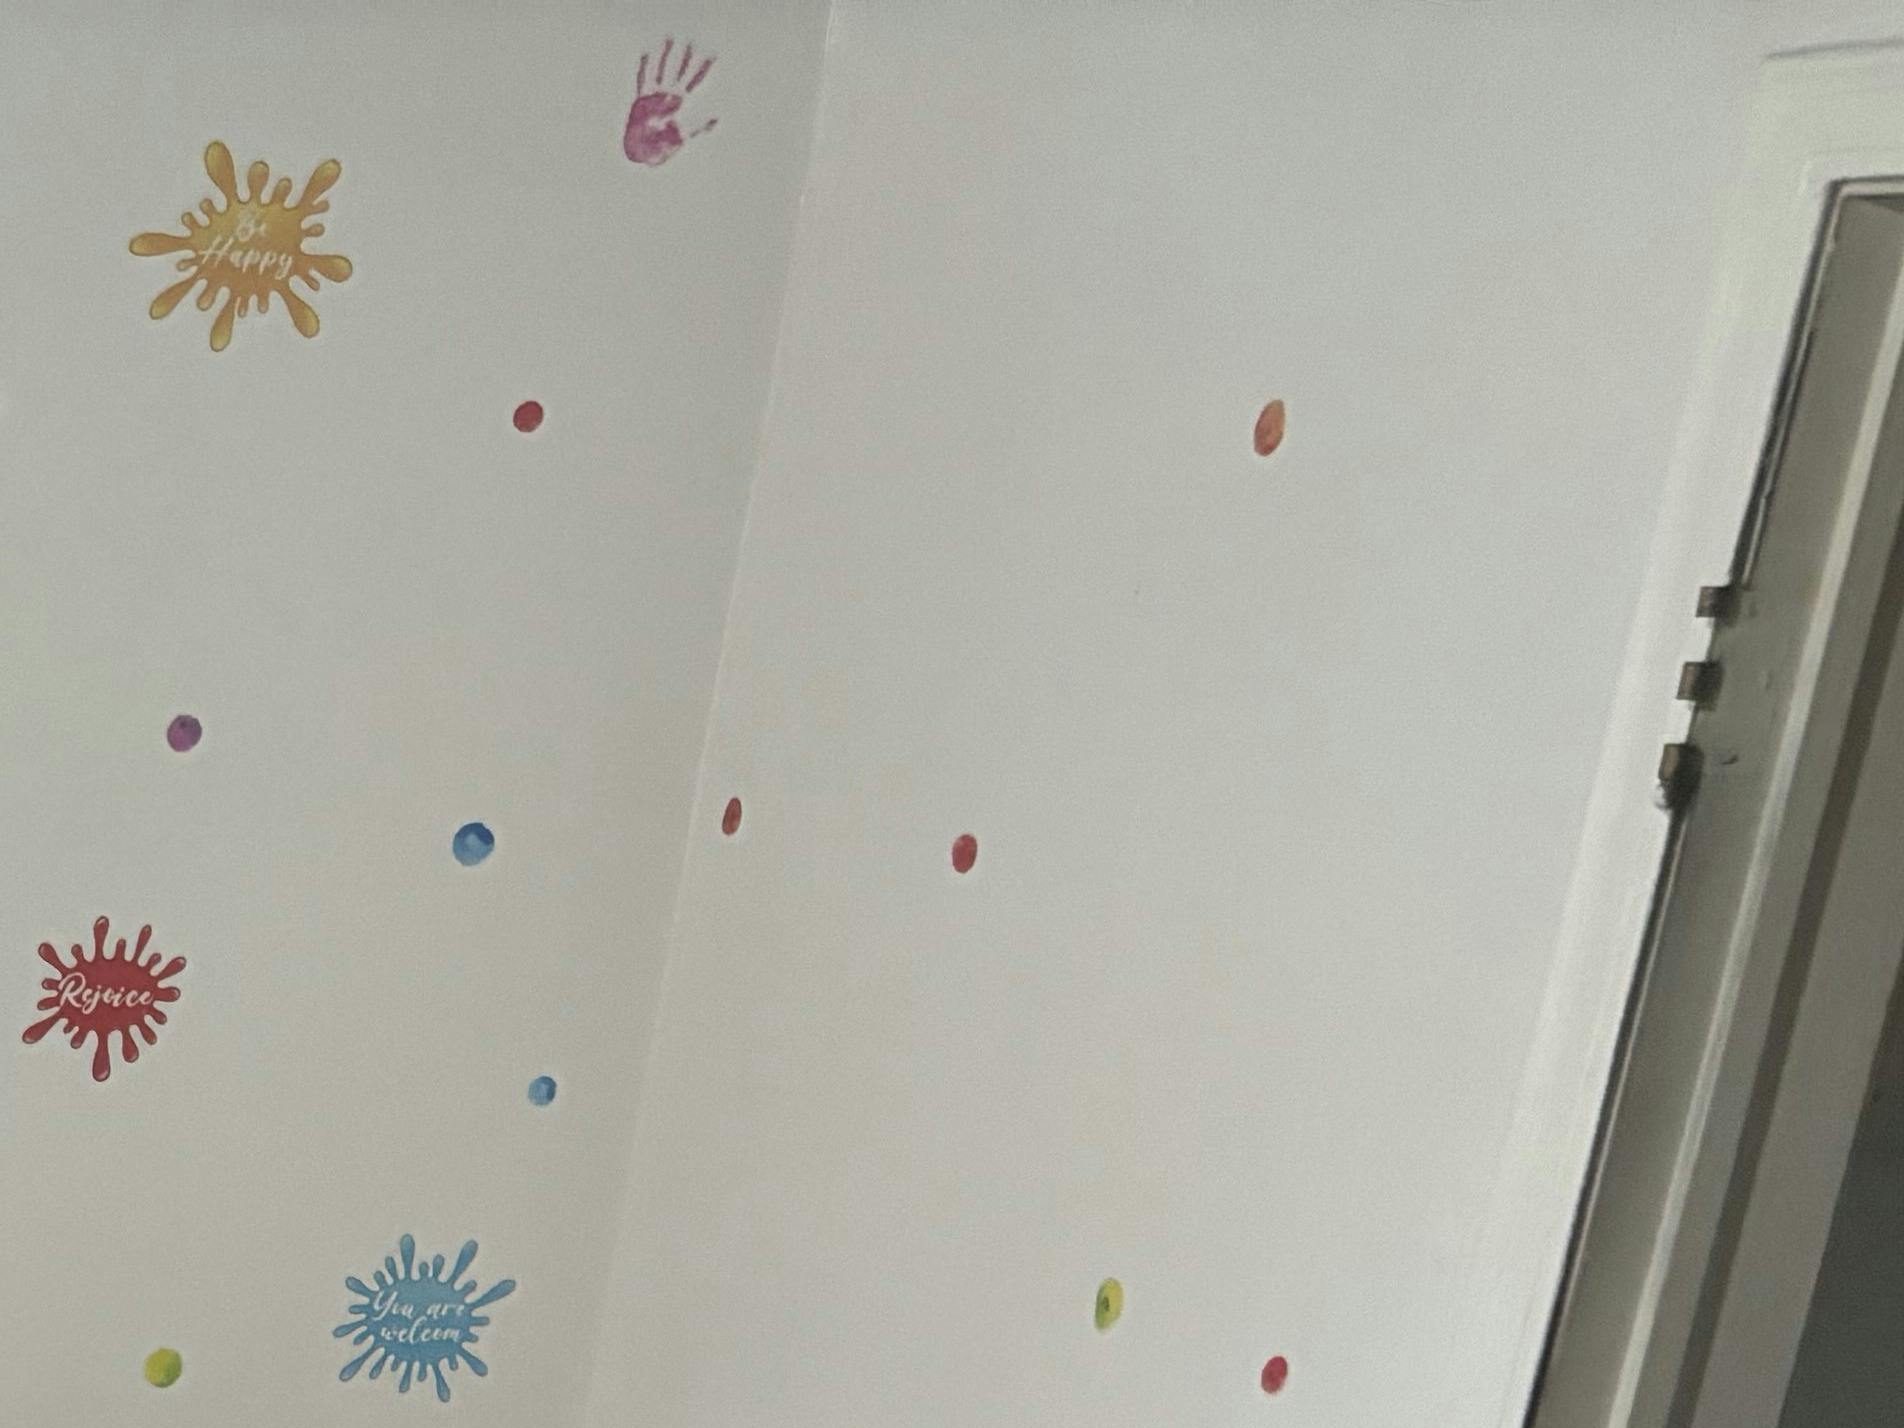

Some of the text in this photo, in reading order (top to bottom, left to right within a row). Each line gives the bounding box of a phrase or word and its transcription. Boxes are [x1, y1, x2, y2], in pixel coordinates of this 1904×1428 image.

[198, 236, 292, 280] Happy
[58, 972, 153, 1015] Rejoice
[373, 1291, 465, 1321] You are
